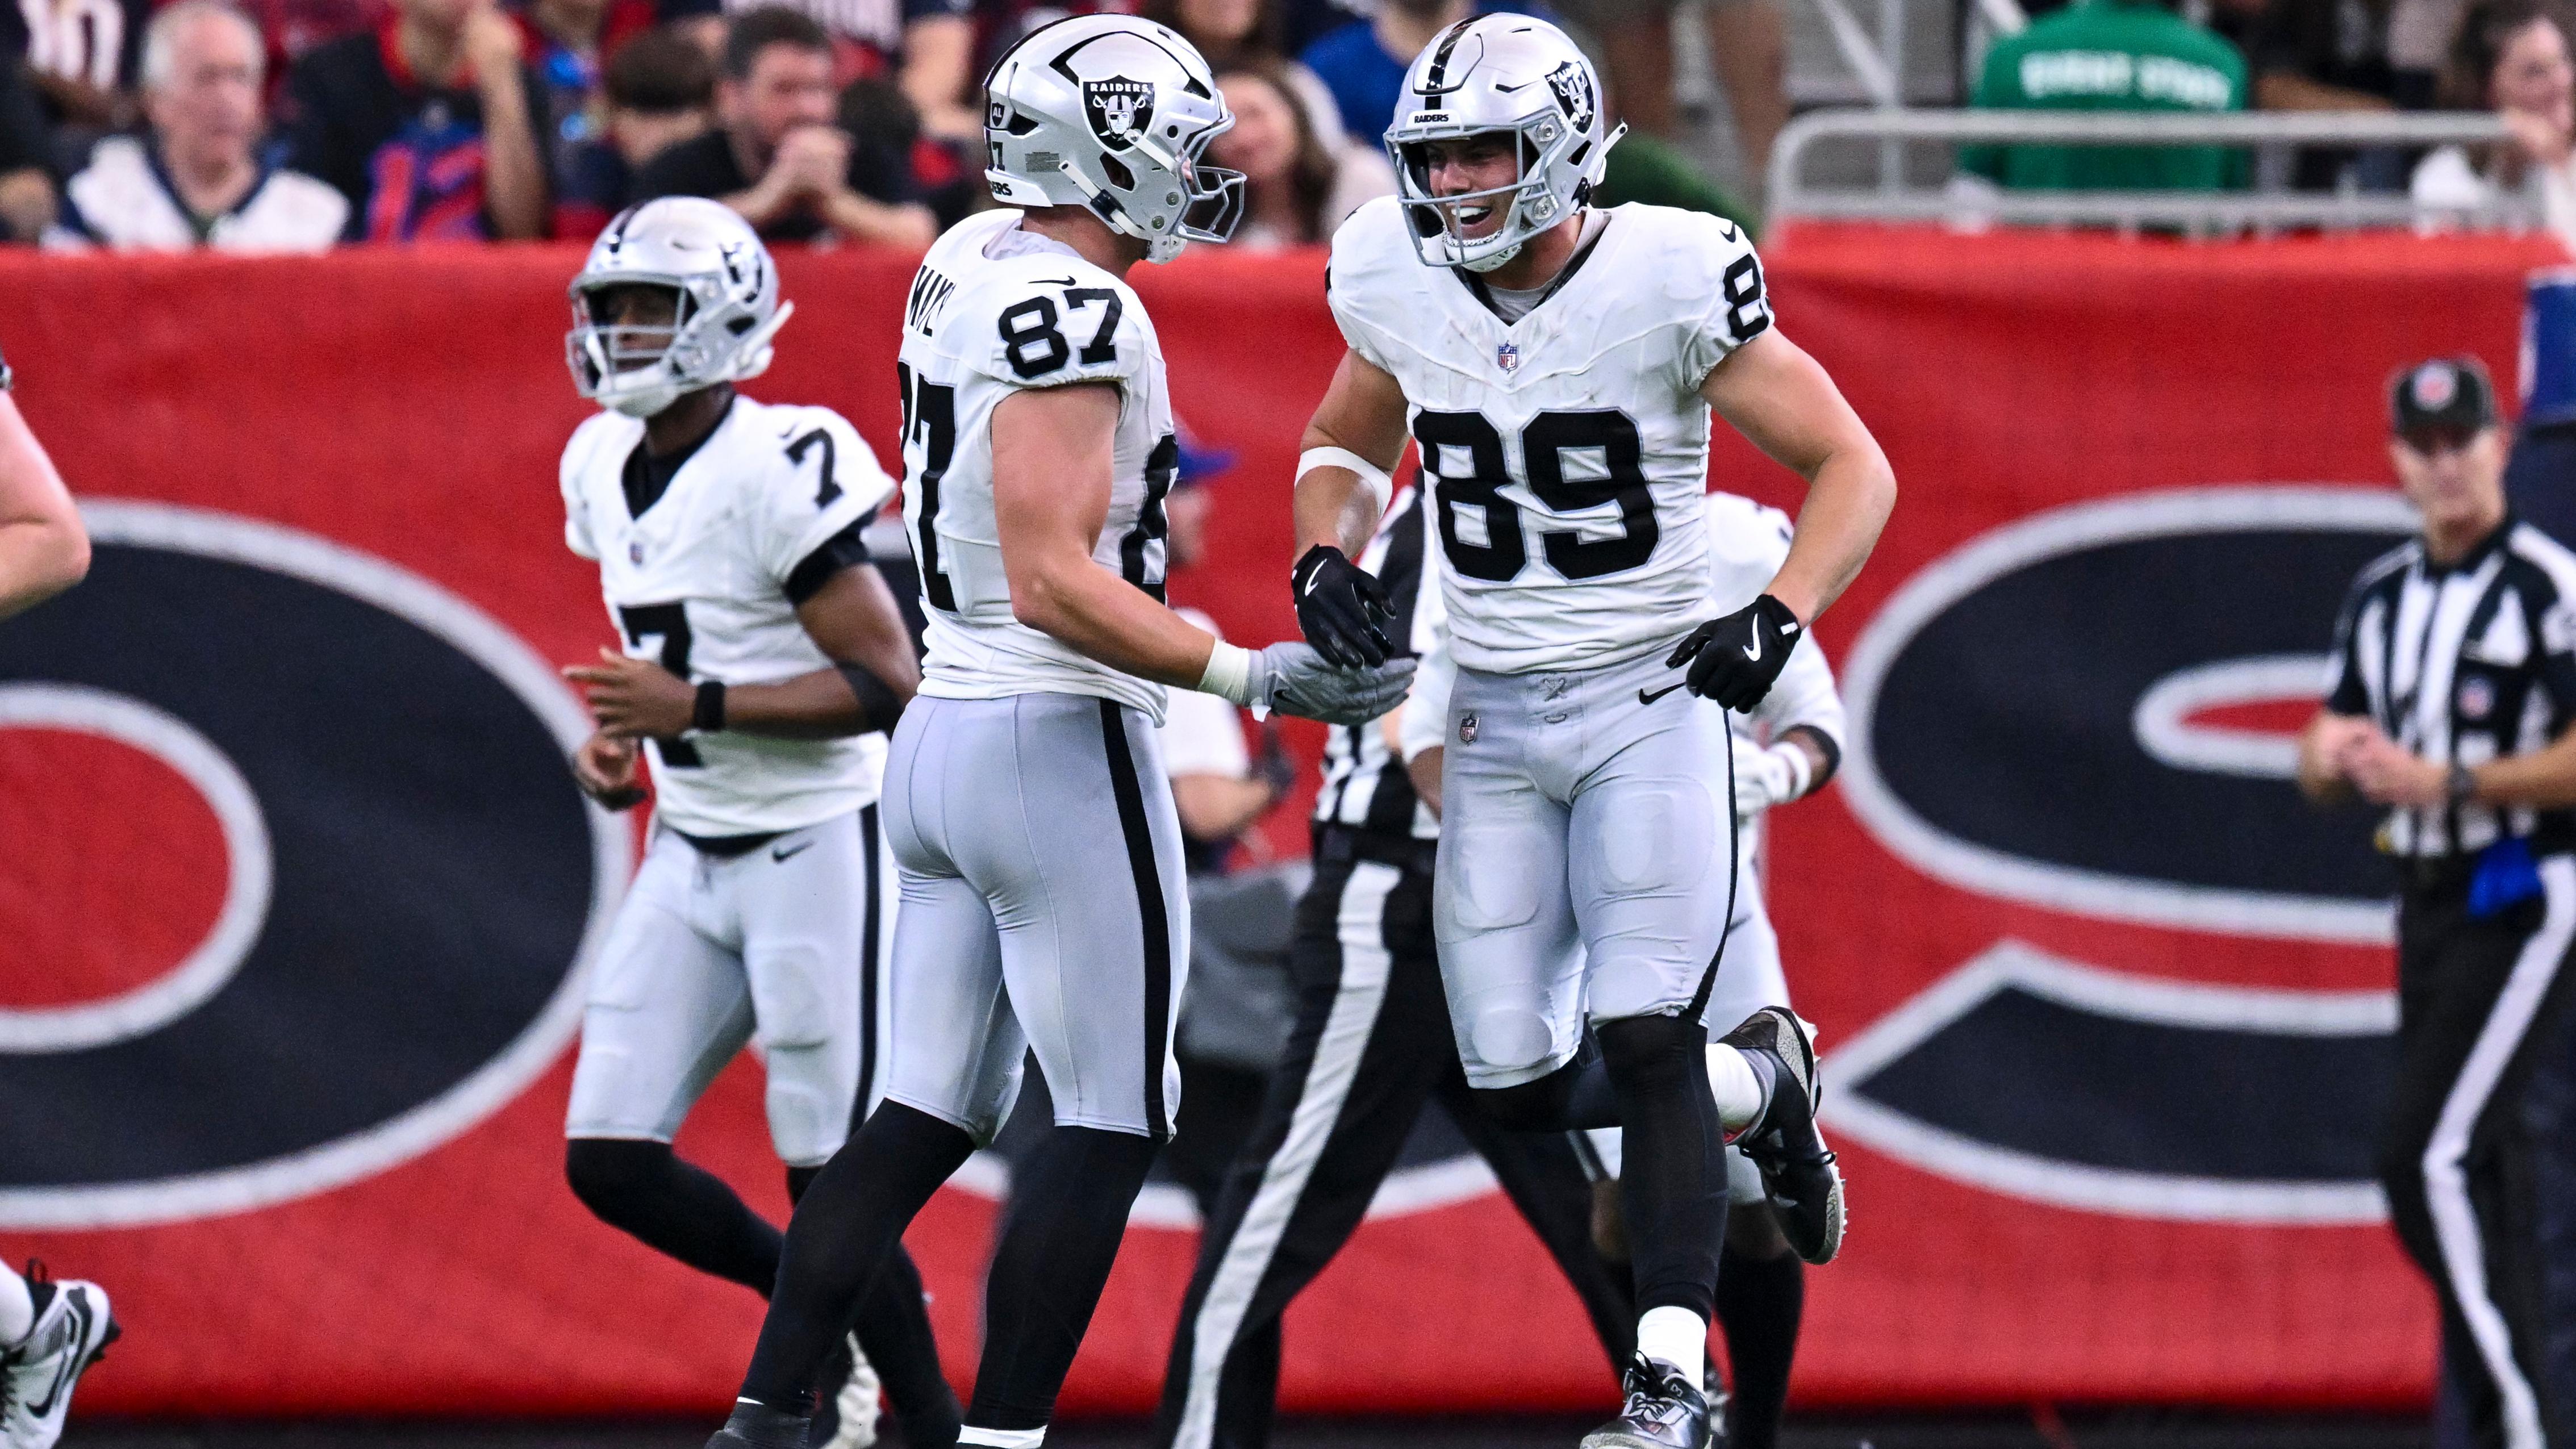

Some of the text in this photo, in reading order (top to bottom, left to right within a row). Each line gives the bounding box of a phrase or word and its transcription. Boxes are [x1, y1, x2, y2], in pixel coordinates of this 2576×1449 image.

[992, 106, 1002, 118] AL
[1090, 83, 1149, 92] RAIDERS
[1414, 114, 1449, 123] RAIDERS
[998, 287, 1122, 379] 87
[1722, 253, 1772, 341] 8
[1500, 354, 1515, 368] NFL
[782, 427, 844, 510] 7
[897, 362, 958, 612] 7
[1412, 408, 1661, 584] 89
[617, 599, 705, 768] 7
